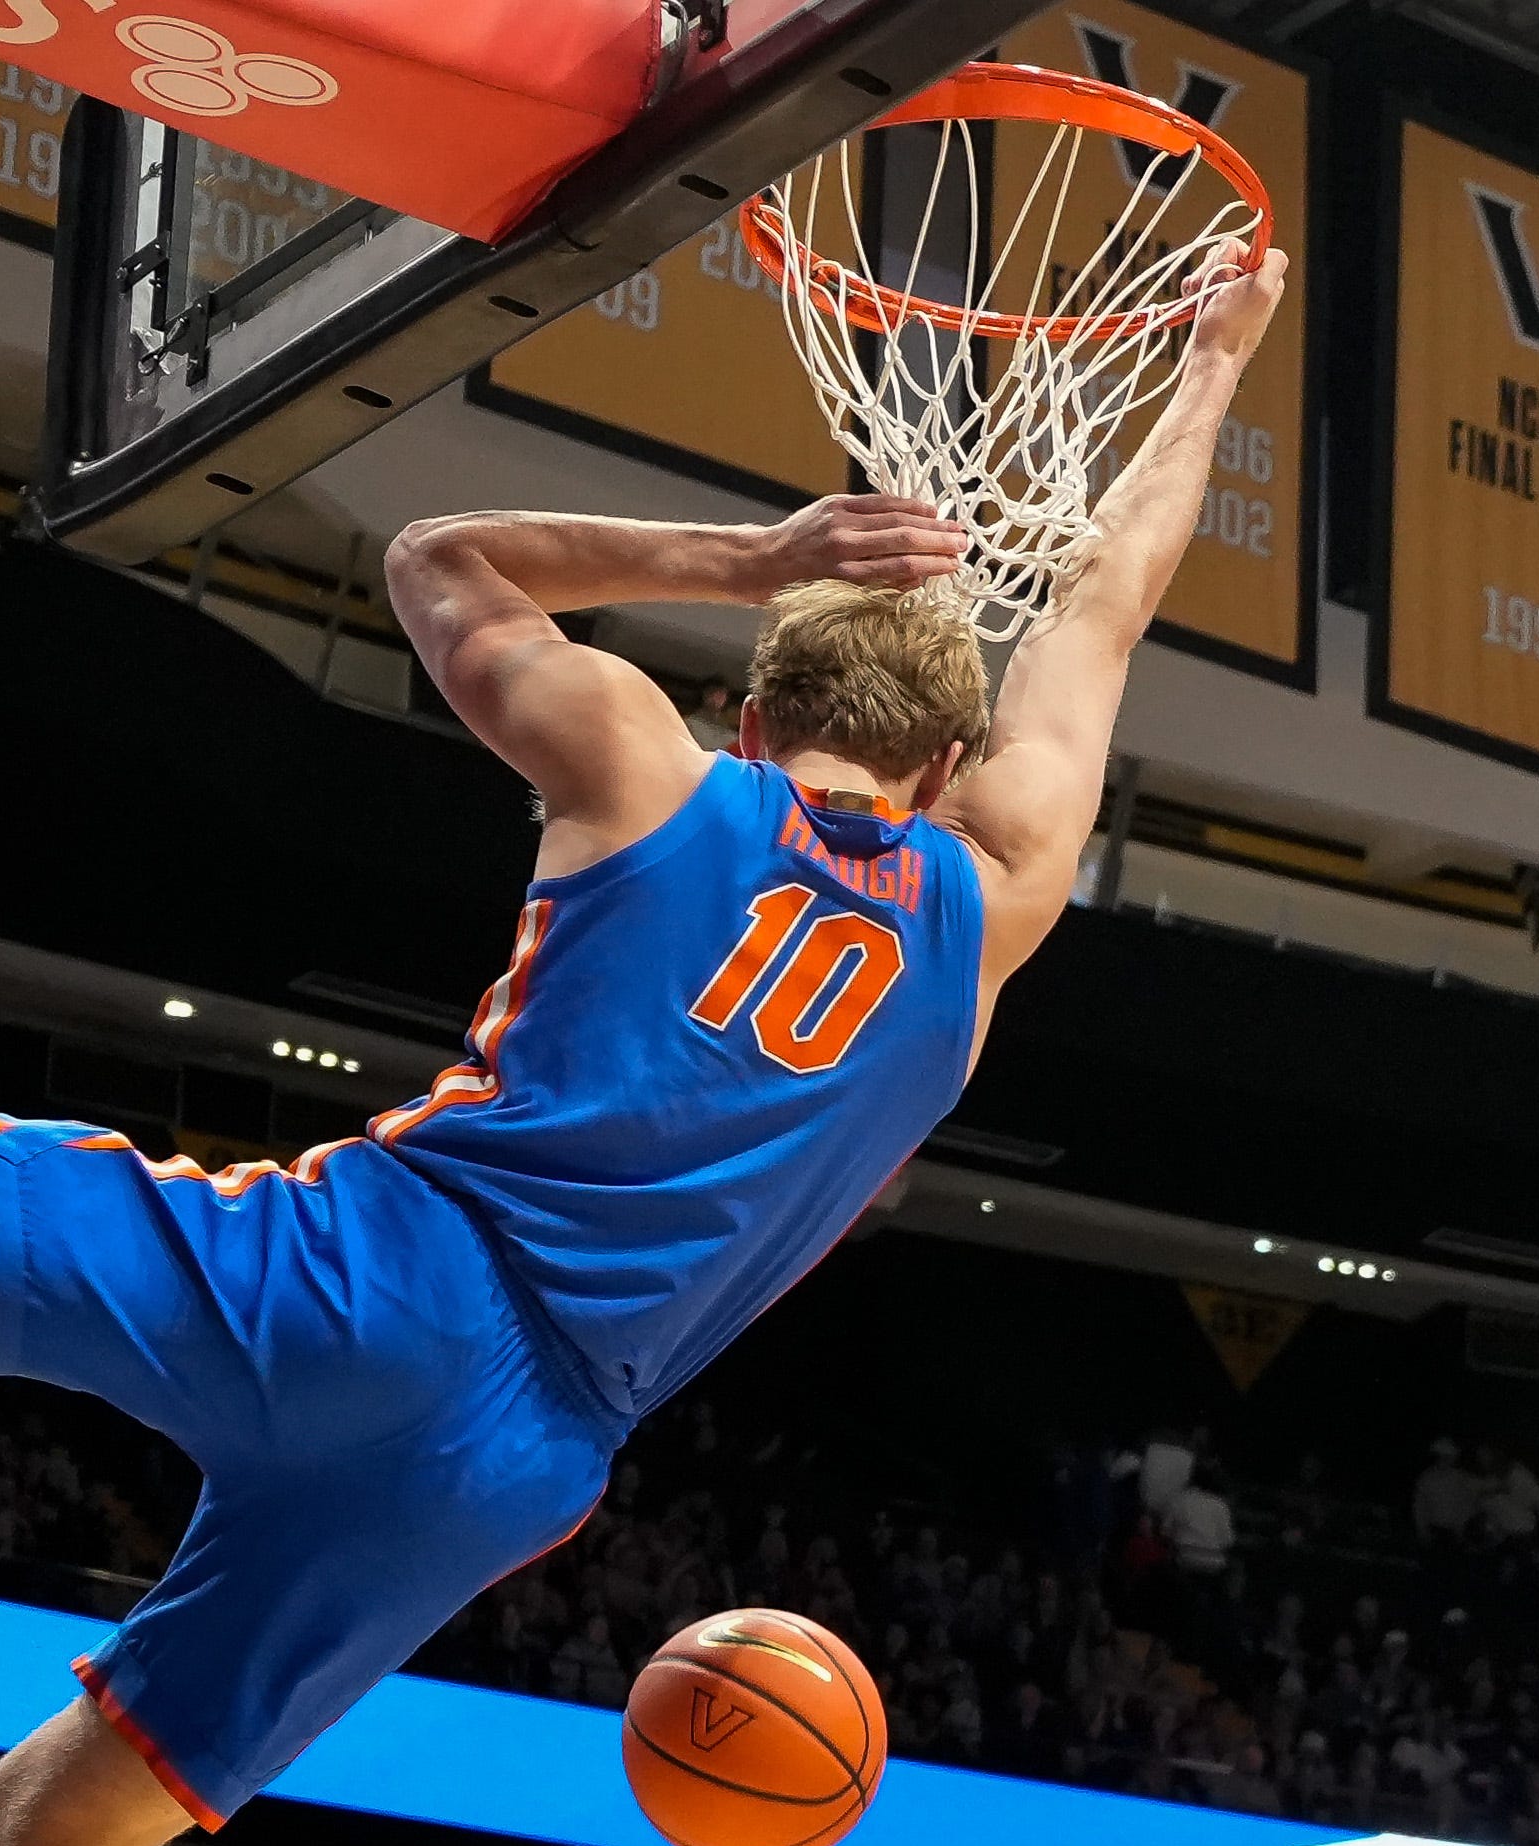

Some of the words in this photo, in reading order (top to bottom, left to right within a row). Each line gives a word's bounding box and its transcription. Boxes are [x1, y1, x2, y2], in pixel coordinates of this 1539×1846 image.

[1448, 418, 1536, 501] FINAL
[688, 882, 905, 1074] 10
[691, 1687, 754, 1752] V
